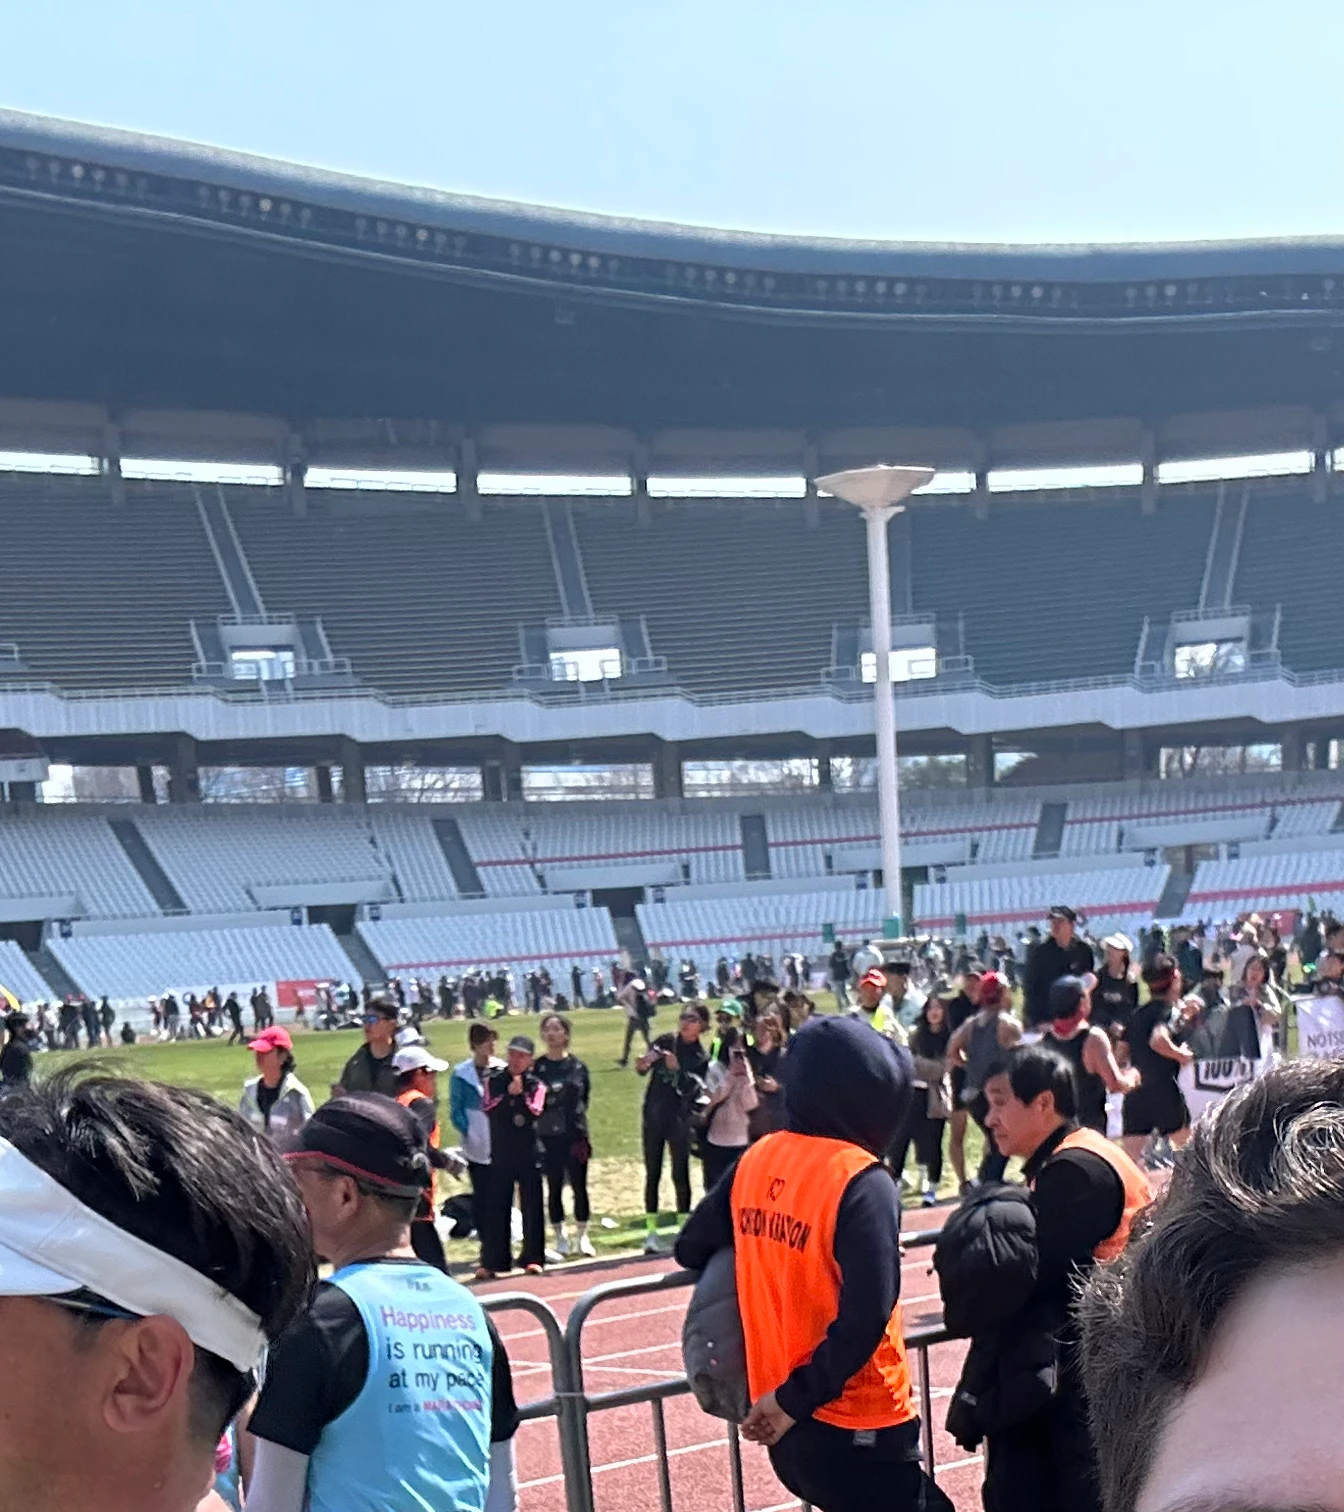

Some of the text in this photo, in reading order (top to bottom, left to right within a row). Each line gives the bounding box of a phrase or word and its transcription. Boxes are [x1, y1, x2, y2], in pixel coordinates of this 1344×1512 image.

[379, 1305, 478, 1333] Happiness
[386, 1336, 485, 1364] is running
[388, 1368, 408, 1389] at
[414, 1372, 440, 1392] my
